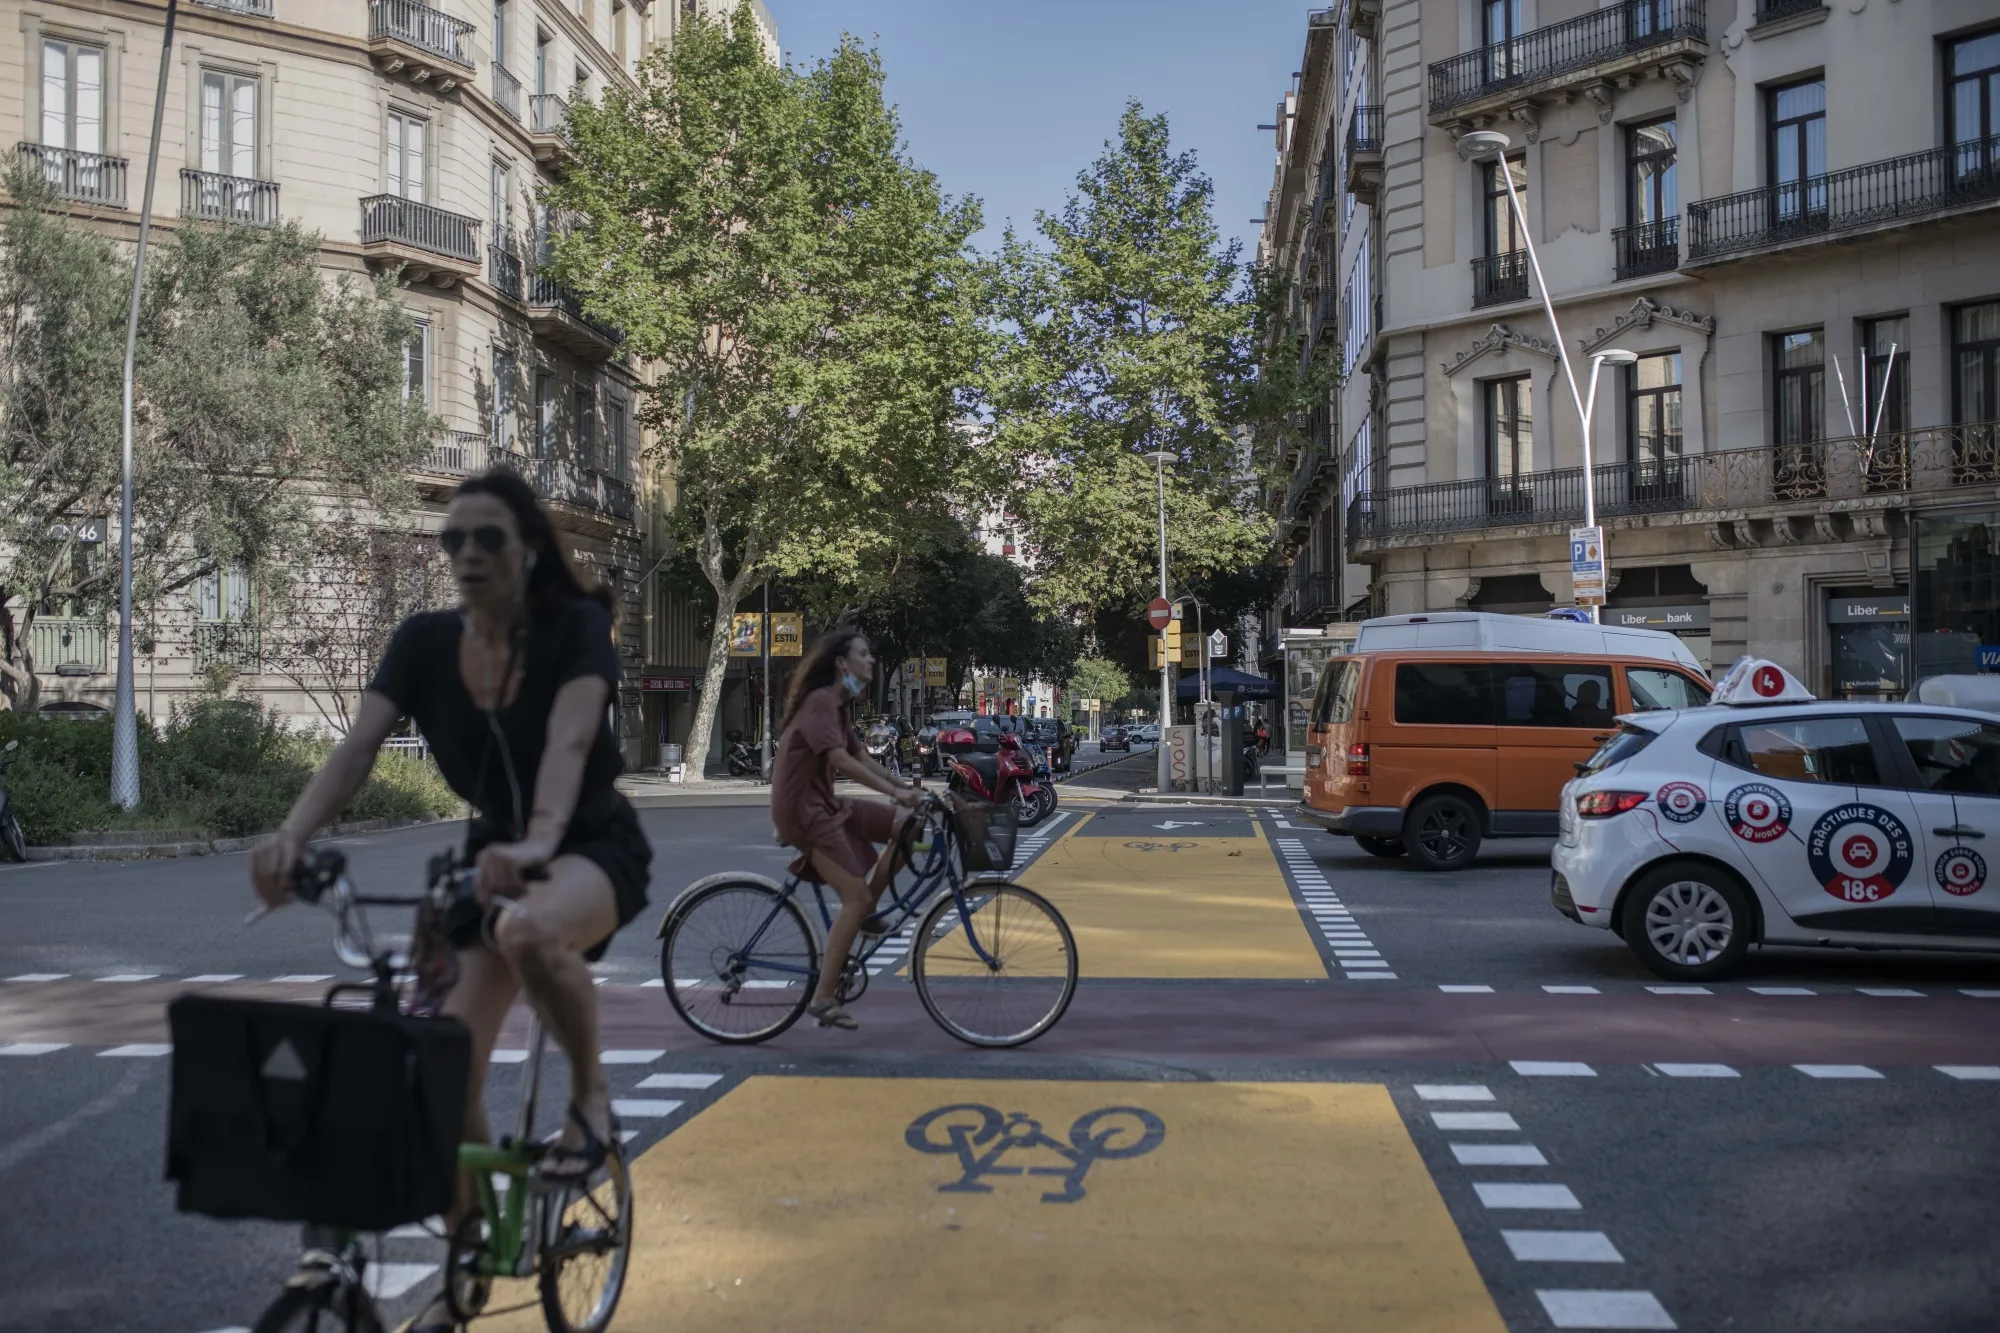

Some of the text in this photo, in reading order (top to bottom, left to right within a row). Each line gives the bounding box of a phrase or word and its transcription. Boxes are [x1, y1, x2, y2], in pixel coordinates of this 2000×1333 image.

[1574, 543, 1583, 561] P
[1847, 604, 1879, 616] Liber
[1621, 612, 1693, 625] Liber bank
[774, 633, 798, 643] ESTIU
[1762, 674, 1776, 690] 4
[1743, 785, 1787, 806] INTENSIVA
[1738, 824, 1783, 839] 18 HORES
[1813, 807, 1908, 858] PRÀCTIQUES DES DE
[1841, 879, 1879, 900] 18€
[1946, 880, 1981, 893] BUS AULA
